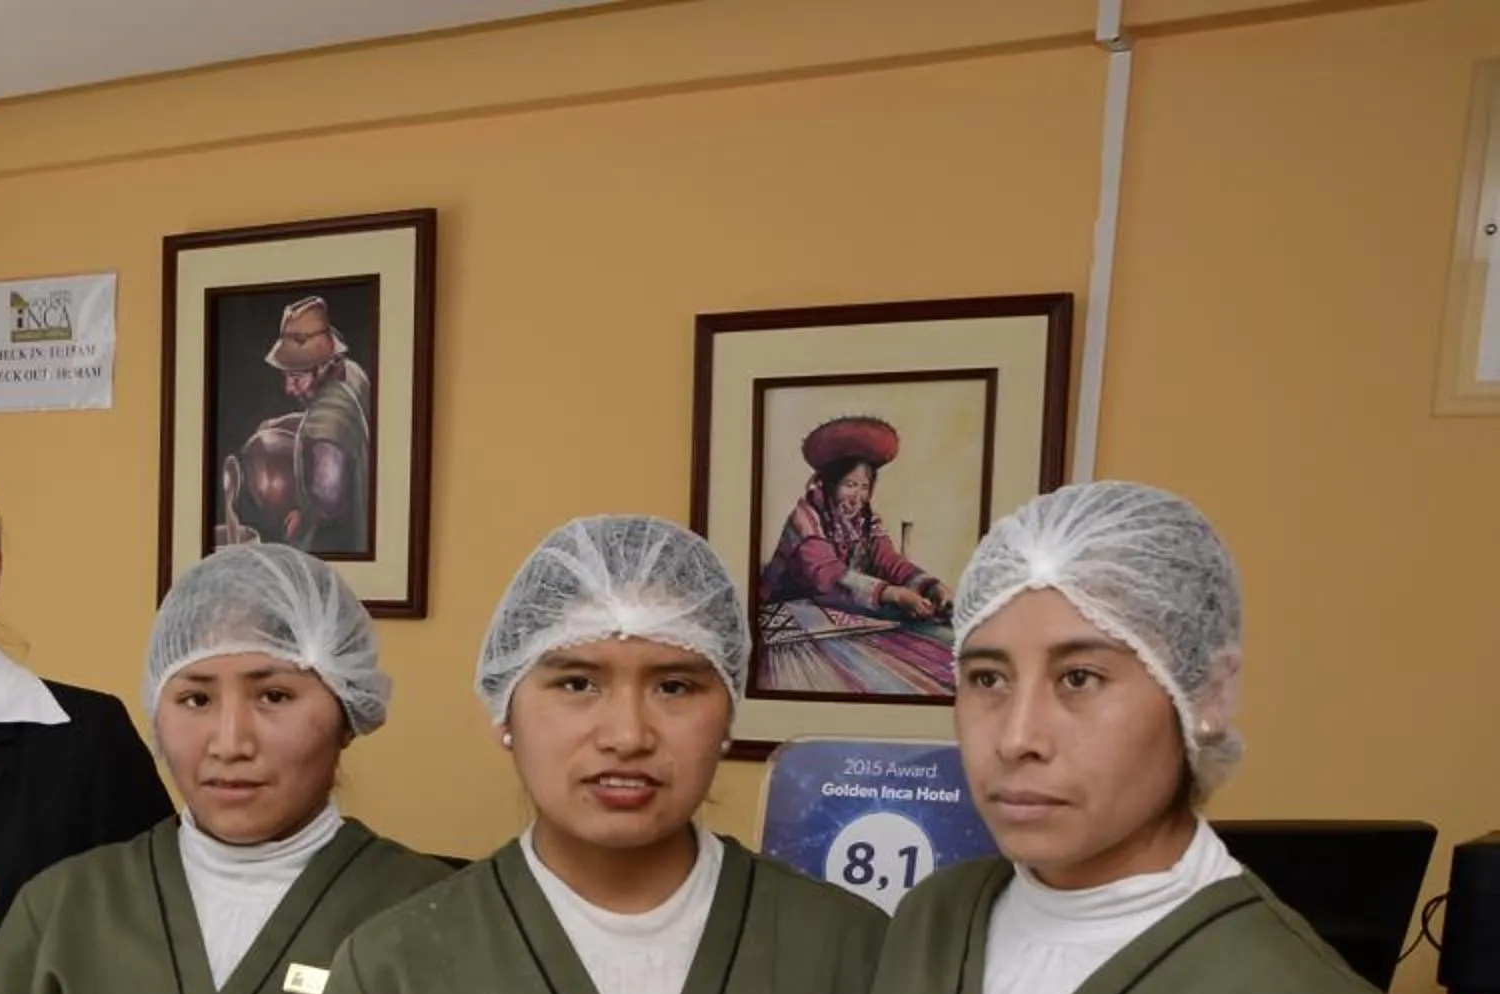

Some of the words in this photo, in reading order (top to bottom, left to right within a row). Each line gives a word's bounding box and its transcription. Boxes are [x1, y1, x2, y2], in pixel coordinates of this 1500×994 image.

[843, 758, 882, 776] 2015
[885, 761, 938, 779] Award
[821, 782, 878, 798] Golden
[881, 785, 913, 800] Inca
[916, 786, 961, 803] Hotel
[843, 841, 919, 891] 8,1
